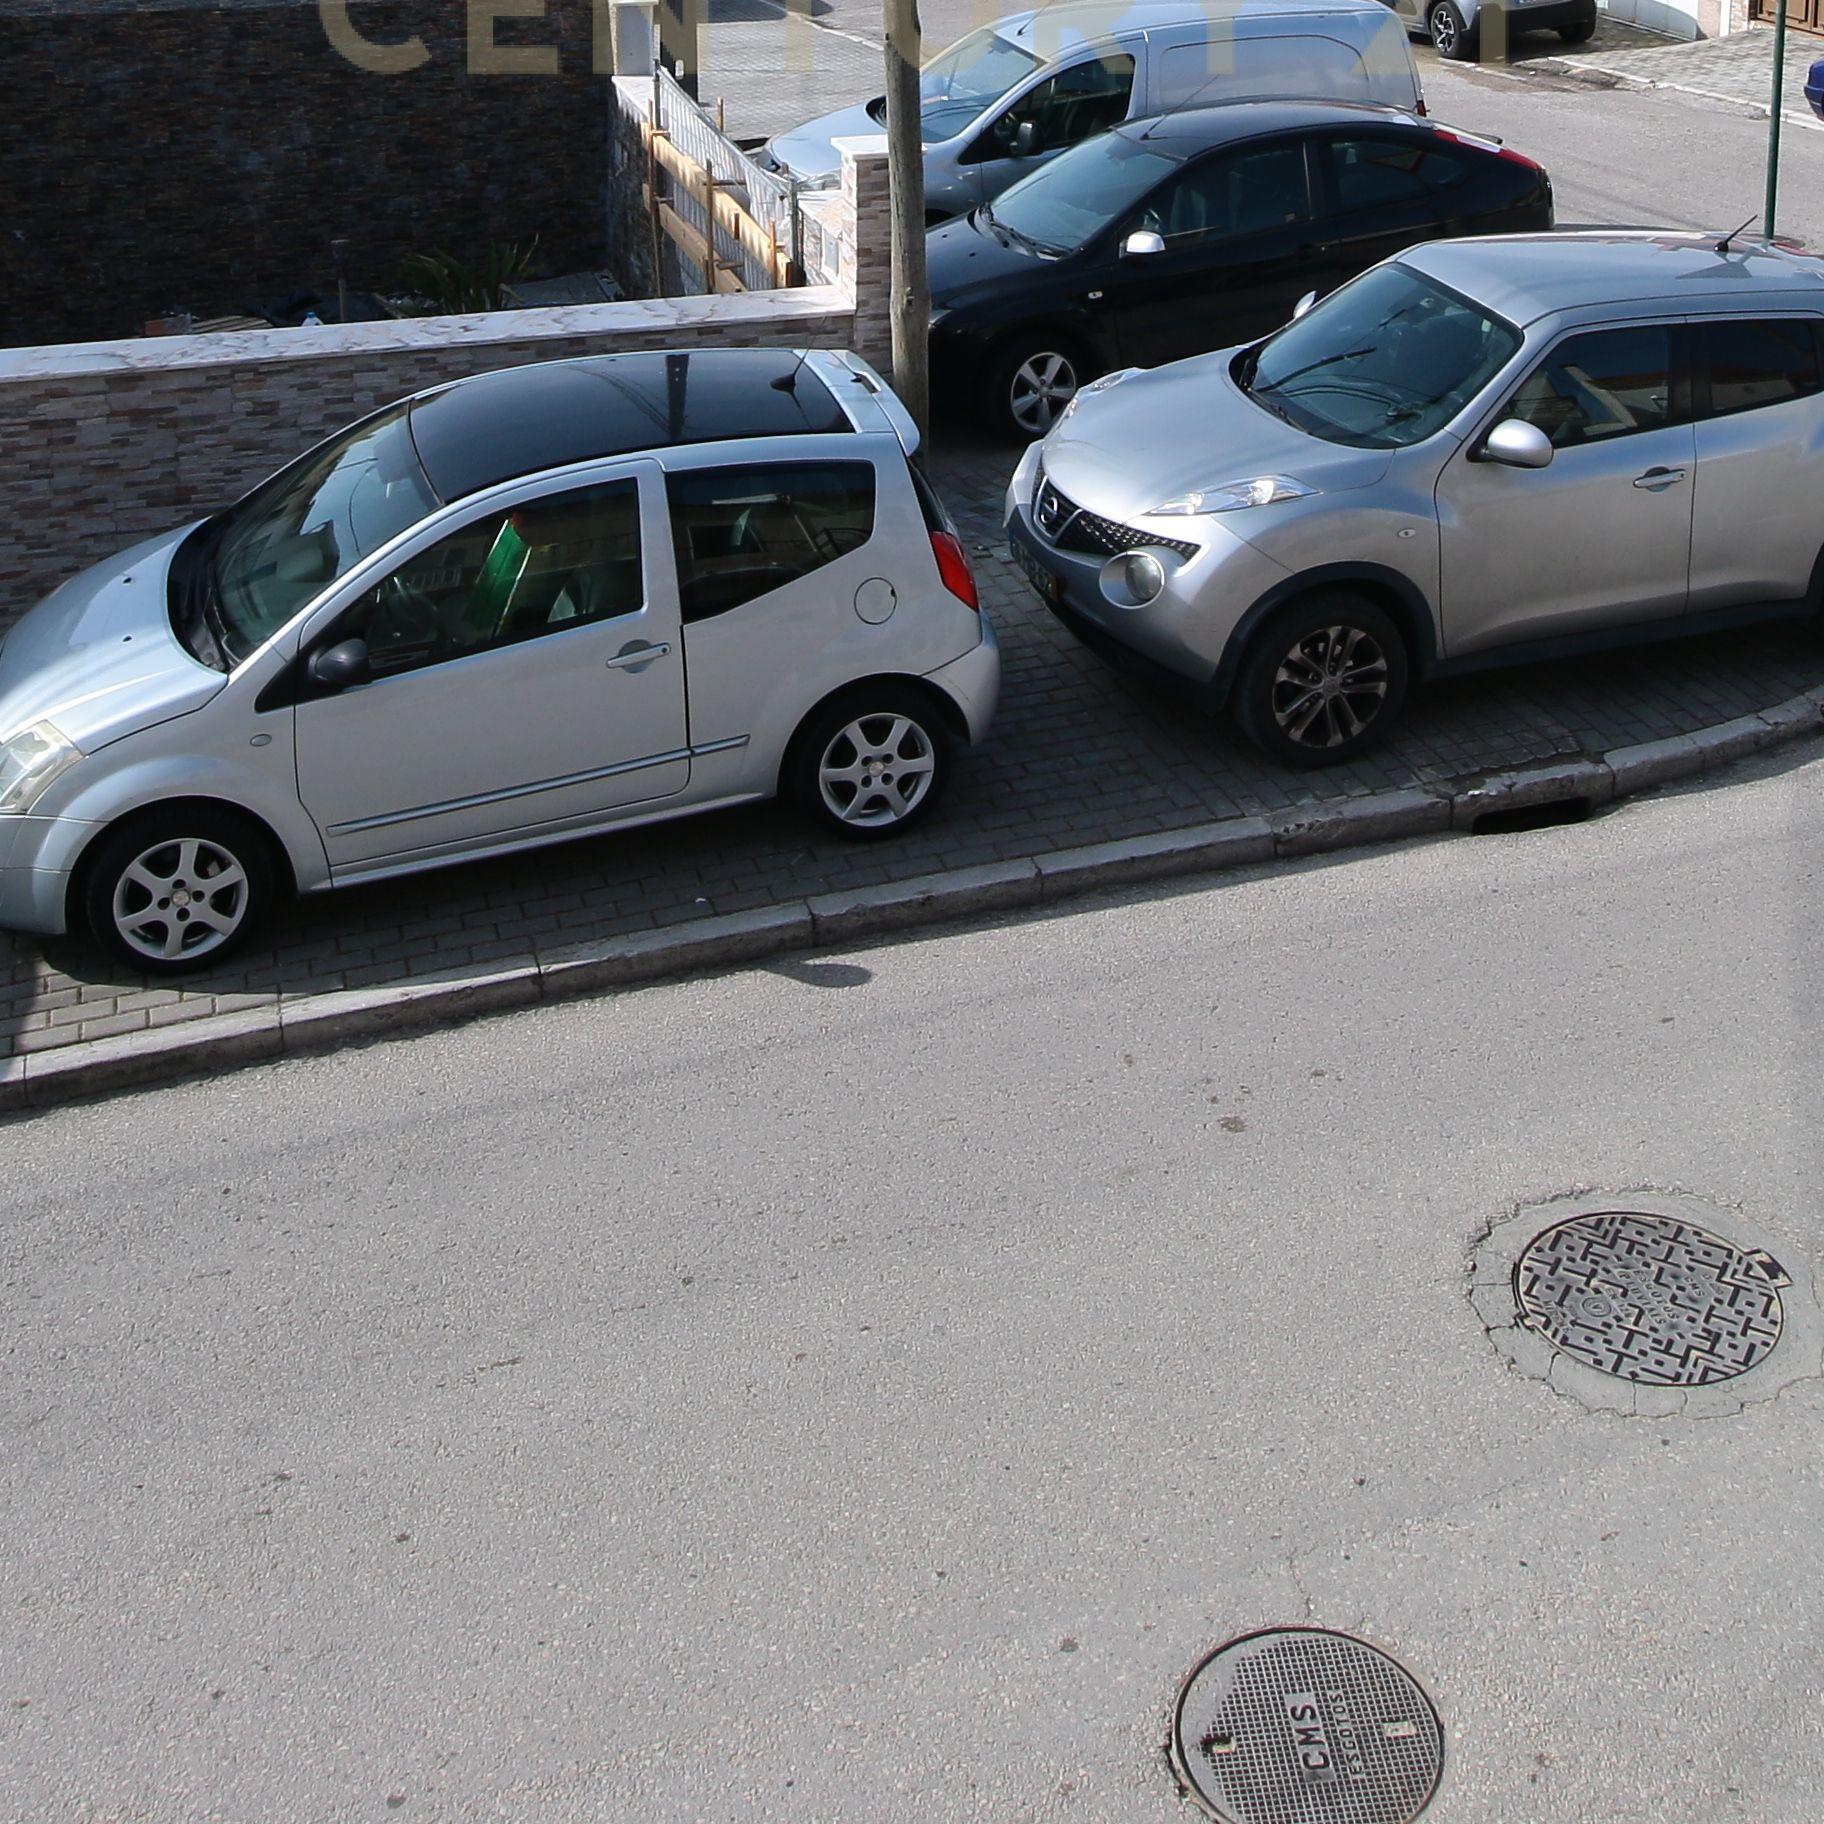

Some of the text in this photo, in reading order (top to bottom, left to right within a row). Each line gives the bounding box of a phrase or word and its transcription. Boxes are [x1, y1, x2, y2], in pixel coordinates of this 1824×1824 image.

[1617, 1270, 1667, 1325] PLUVIAIS
[1633, 1270, 1680, 1320] ESGOTOS
[1290, 1704, 1331, 1770] CMS
[1329, 1693, 1364, 1775] ESGOTOS
